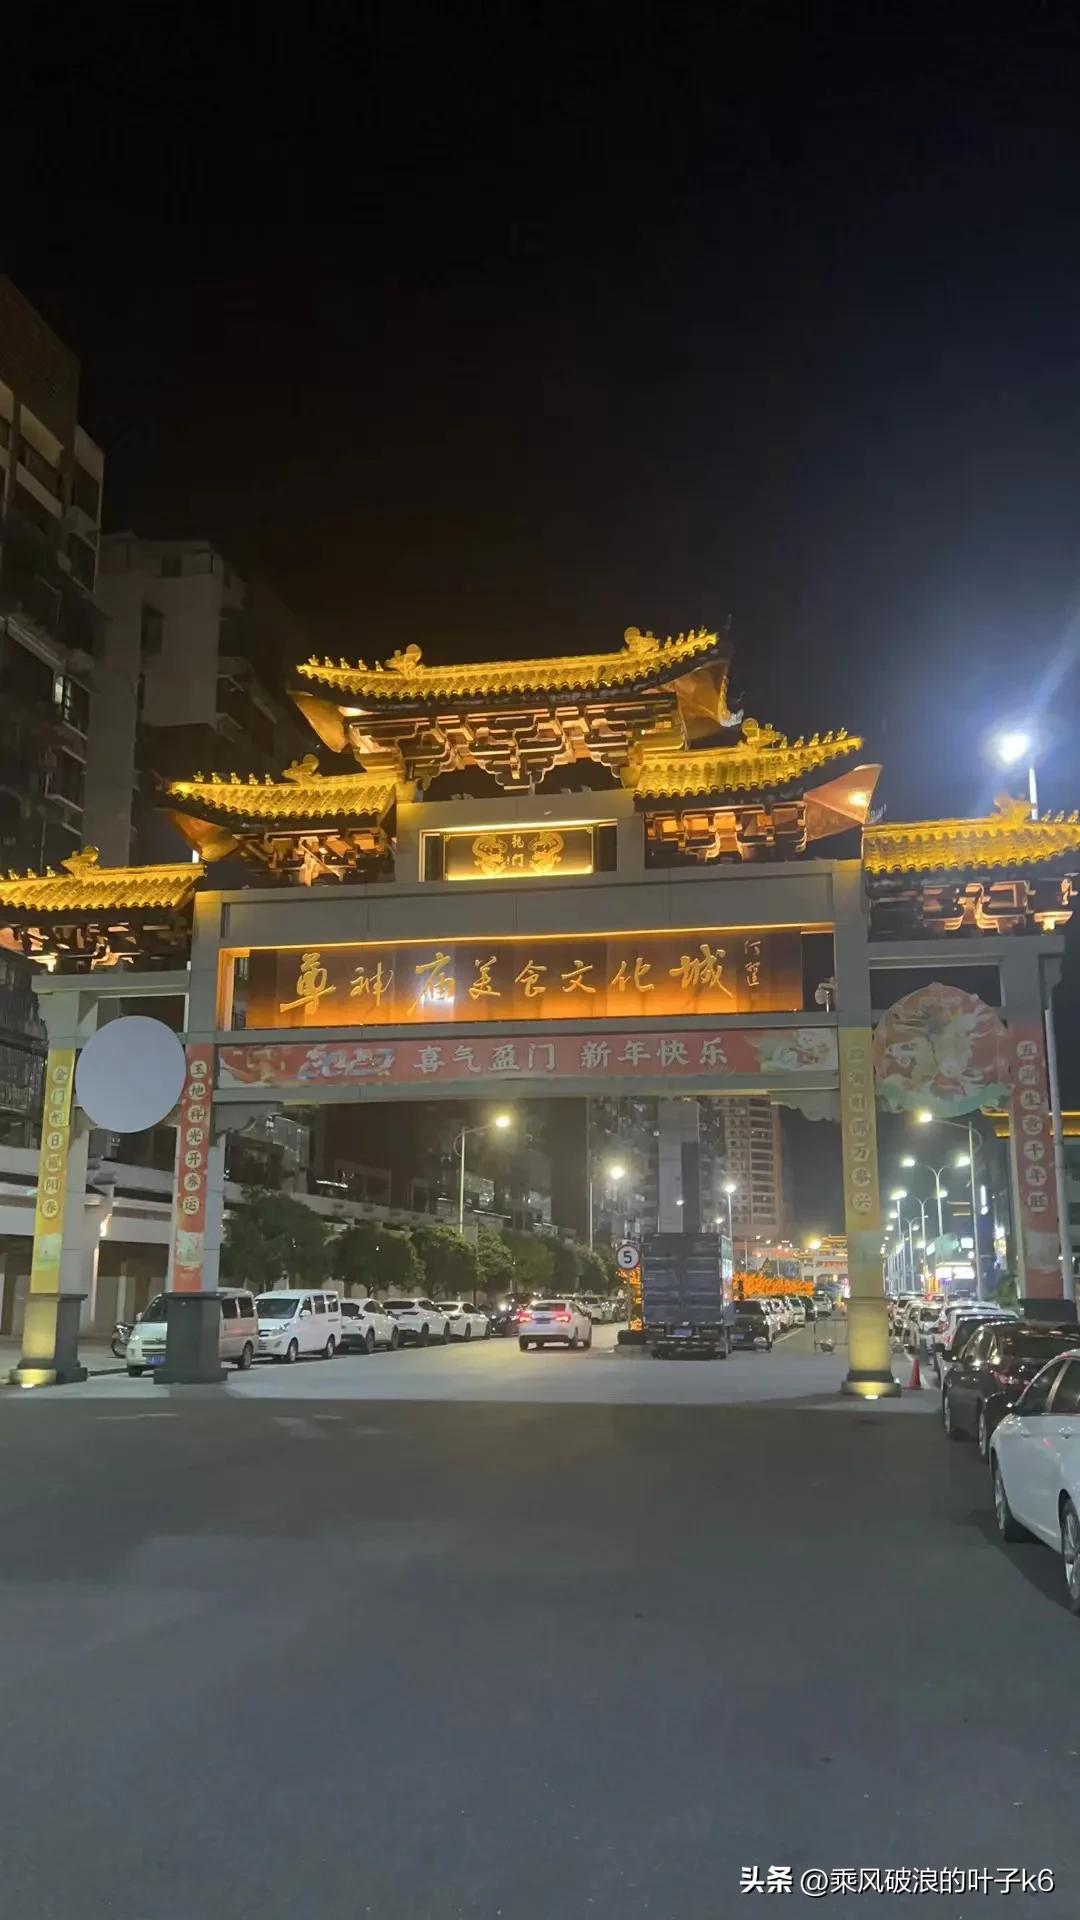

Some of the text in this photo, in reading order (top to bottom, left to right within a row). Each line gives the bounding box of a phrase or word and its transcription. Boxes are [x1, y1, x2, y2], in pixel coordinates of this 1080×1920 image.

[413, 1043, 555, 1075] 喜气盈门
[580, 1037, 728, 1068] 新年快乐
[623, 1250, 632, 1264] 5
